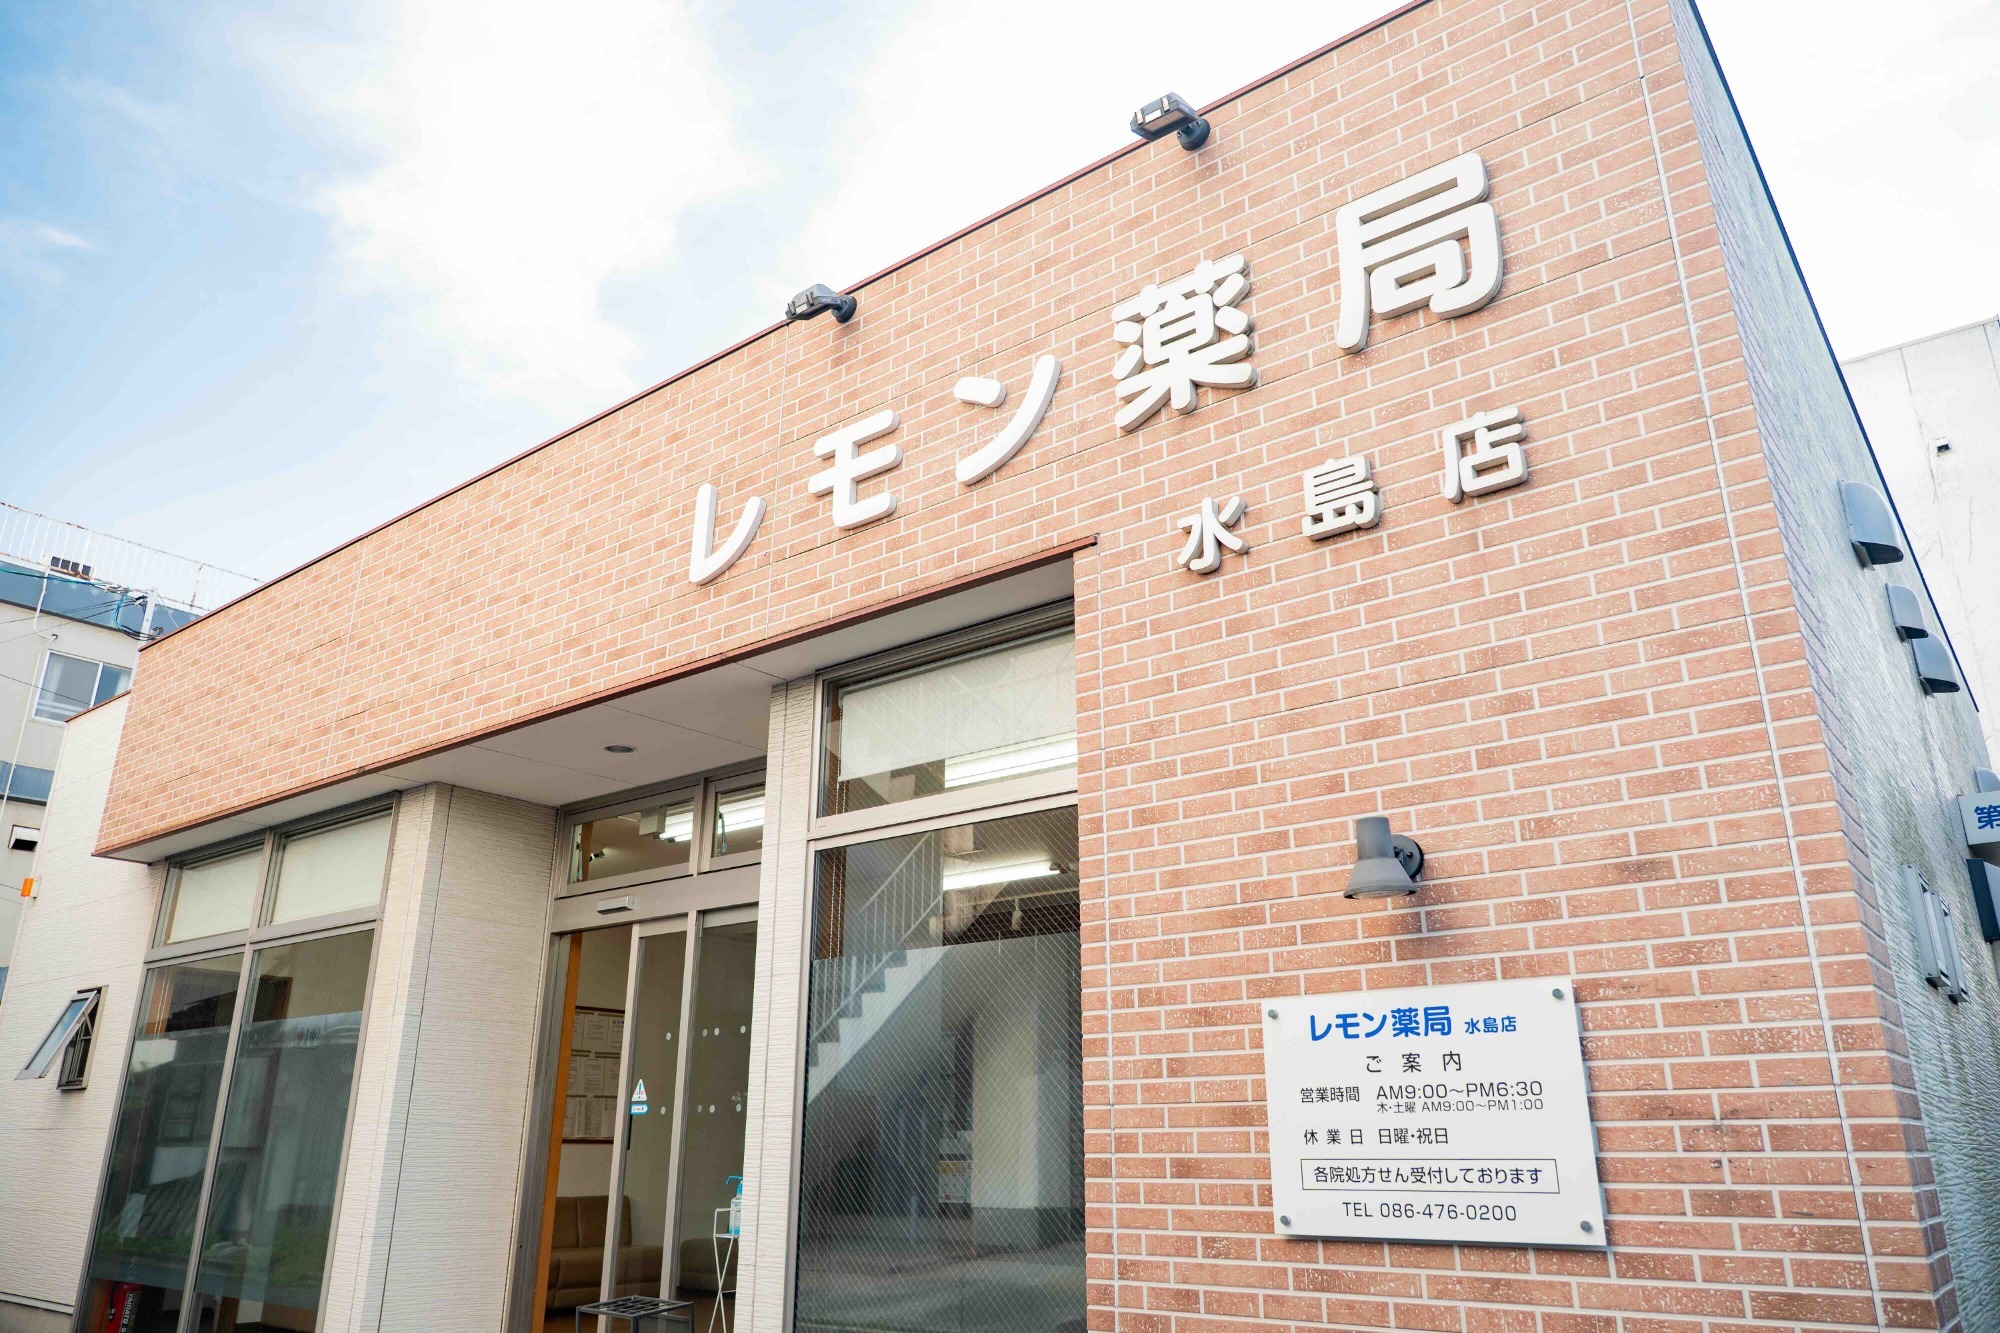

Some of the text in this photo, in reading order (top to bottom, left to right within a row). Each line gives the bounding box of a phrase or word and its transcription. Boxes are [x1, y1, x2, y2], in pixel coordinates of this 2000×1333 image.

[688, 151, 1506, 586] レモン薬局
[1176, 405, 1530, 575] 水島店
[1309, 1005, 1517, 1042] レモン薬局 水島店
[1366, 1050, 1462, 1073] ご案内
[1300, 1086, 1360, 1104] 営業時間
[1378, 1127, 1449, 1145] 日曜・祝日
[1313, 1165, 1543, 1185] 各院処方せん受付しております
[1342, 1202, 1517, 1222] TEL 086-476-0200
